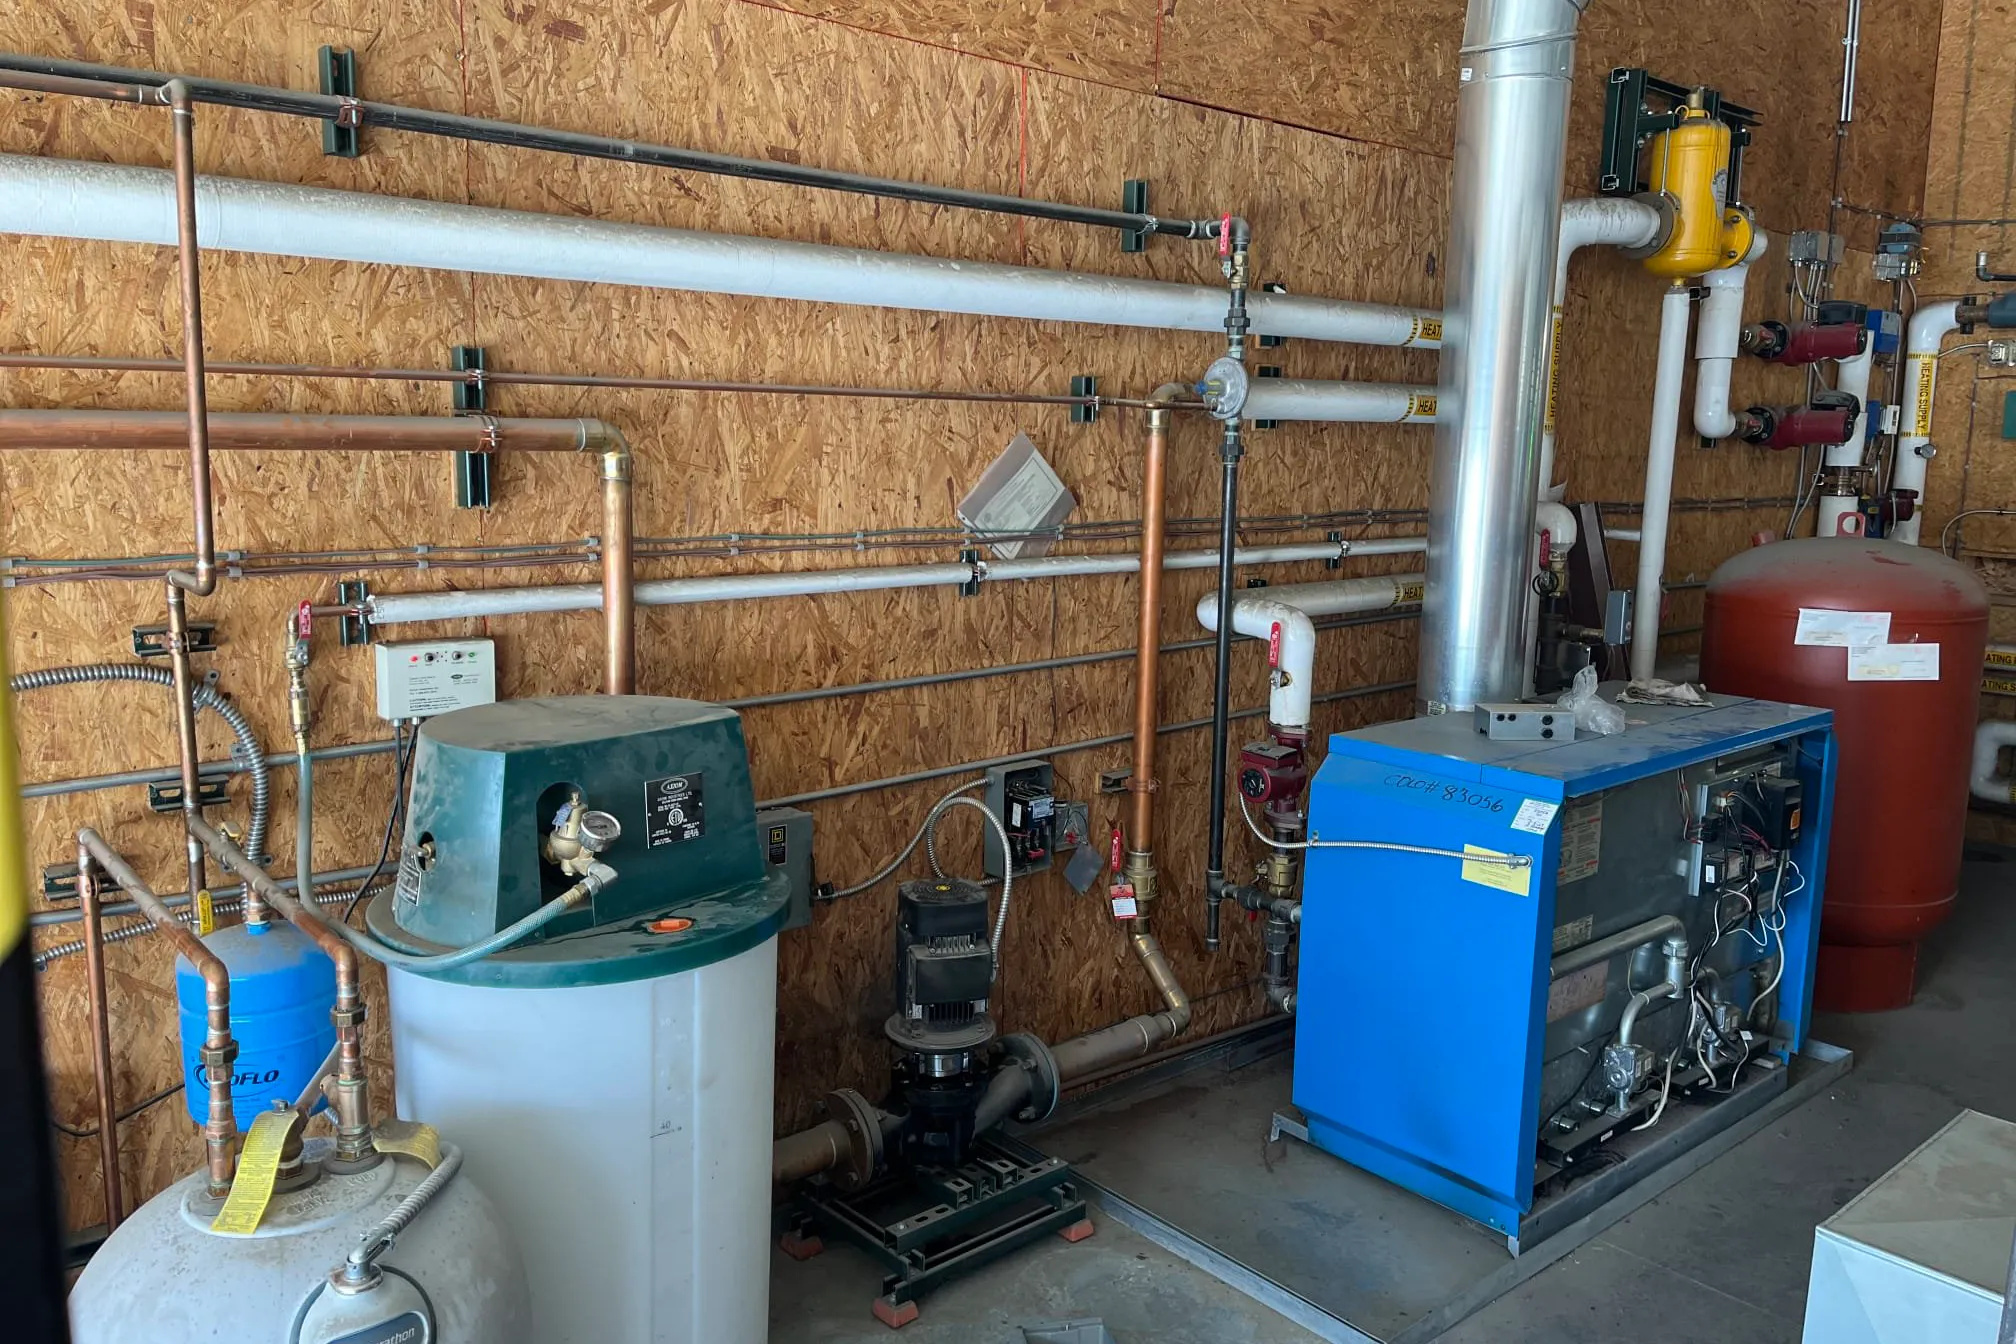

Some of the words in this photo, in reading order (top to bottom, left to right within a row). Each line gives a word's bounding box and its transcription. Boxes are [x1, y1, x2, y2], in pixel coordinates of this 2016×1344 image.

[1422, 323, 1441, 337] HEAT
[1549, 369, 1560, 418] HEATING
[1920, 362, 1930, 397] HEATING
[1917, 399, 1928, 429] SUPPLY
[1442, 785, 1504, 813] 83056
